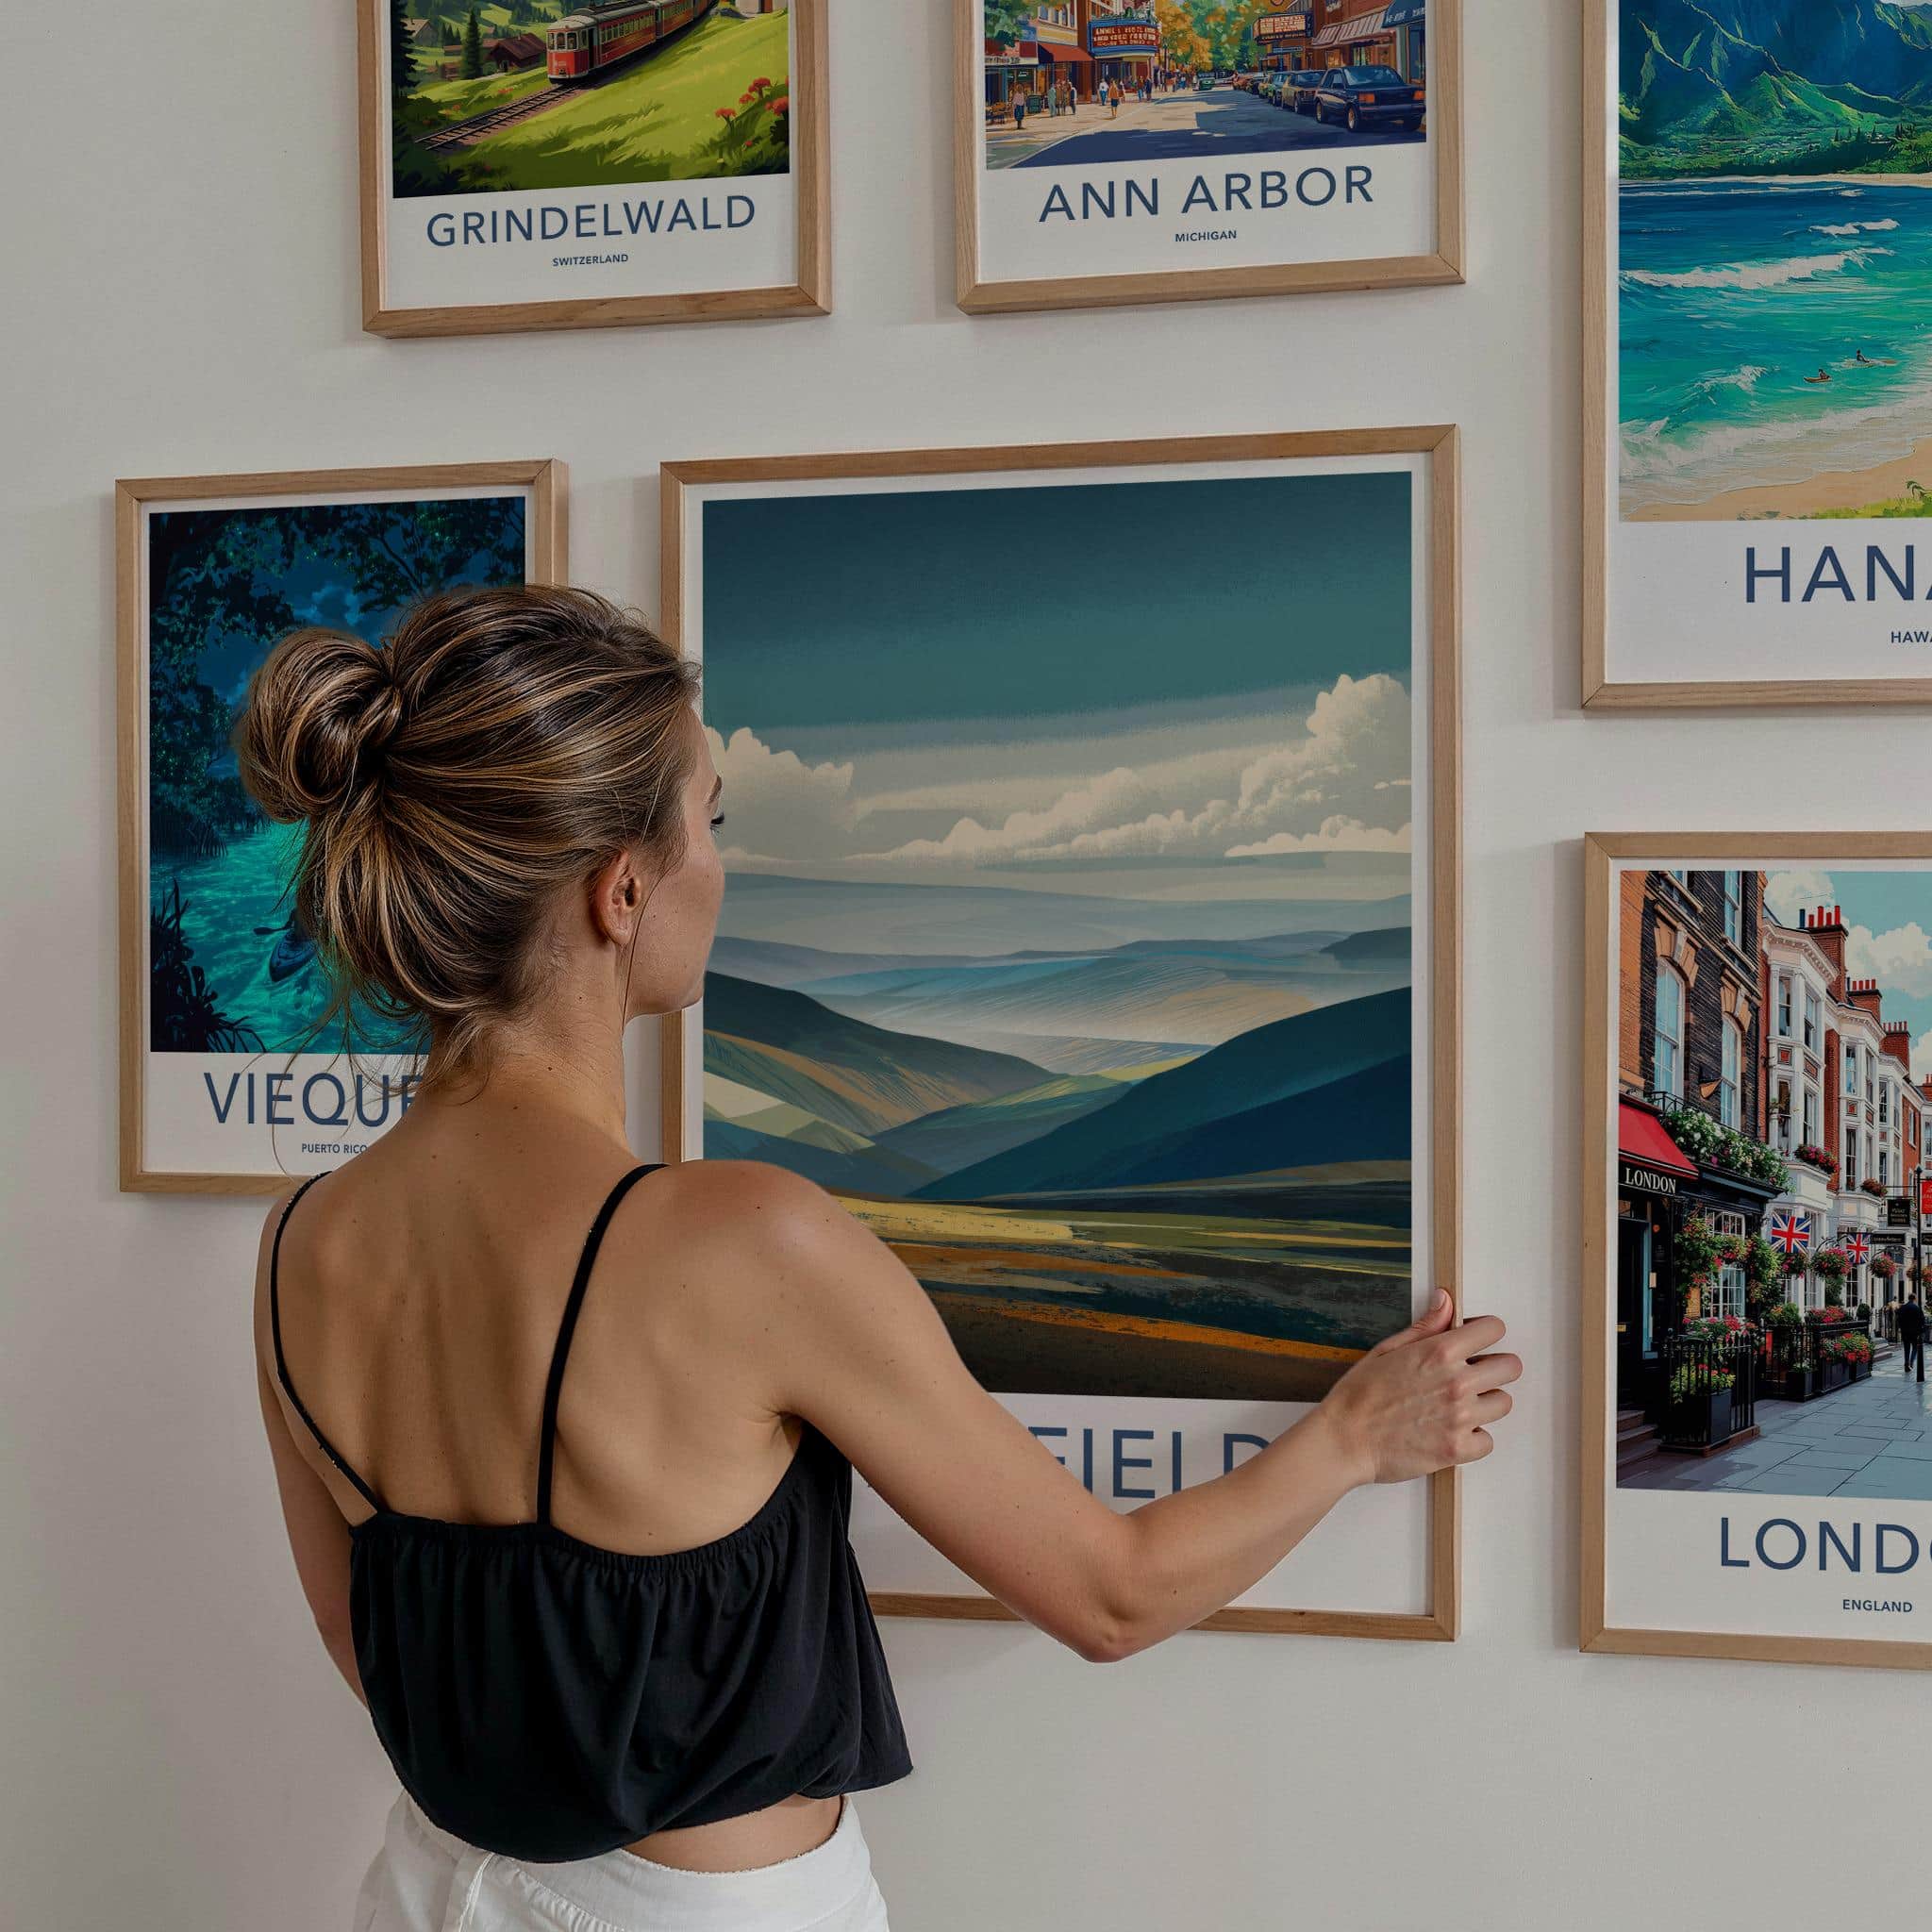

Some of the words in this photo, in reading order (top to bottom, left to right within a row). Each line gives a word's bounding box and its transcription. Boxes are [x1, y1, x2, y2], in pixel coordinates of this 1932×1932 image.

[1039, 178, 1159, 223] ANN
[1181, 165, 1374, 214] ARBOR
[427, 194, 756, 247] GRINDELWALD
[1174, 229, 1238, 242] MICHIGAN
[552, 254, 629, 267] SWITZERLAND
[1745, 544, 1932, 604] HAN
[1890, 630, 1932, 643] HAW
[301, 1142, 341, 1154] PUERTO
[1625, 1167, 1676, 1194] LONDON
[1721, 1516, 1932, 1574] LOND
[1842, 1598, 1913, 1613] ENGLAND
